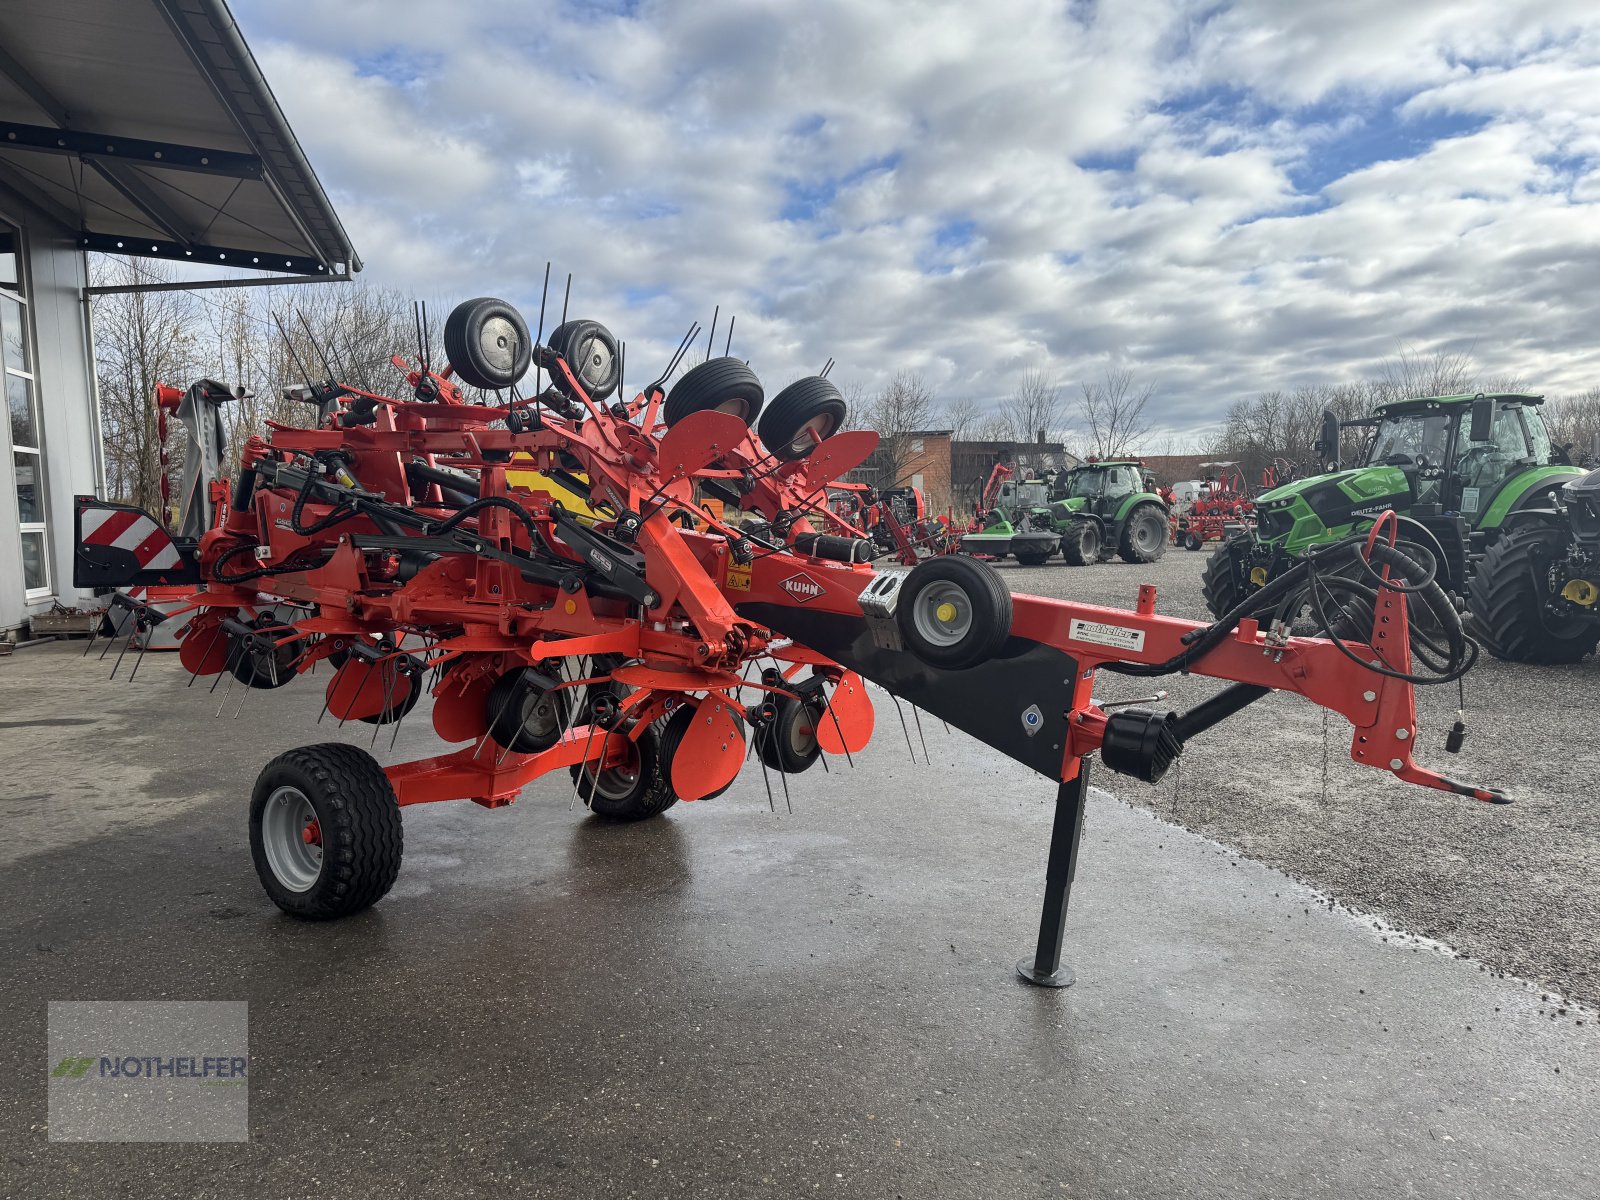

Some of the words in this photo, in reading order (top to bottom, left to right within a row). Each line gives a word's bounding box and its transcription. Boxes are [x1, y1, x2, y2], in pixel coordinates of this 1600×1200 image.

[1351, 503, 1392, 516] DEUTZ-FAHR
[785, 580, 819, 595] KUHN
[1084, 622, 1132, 638] nothelfer
